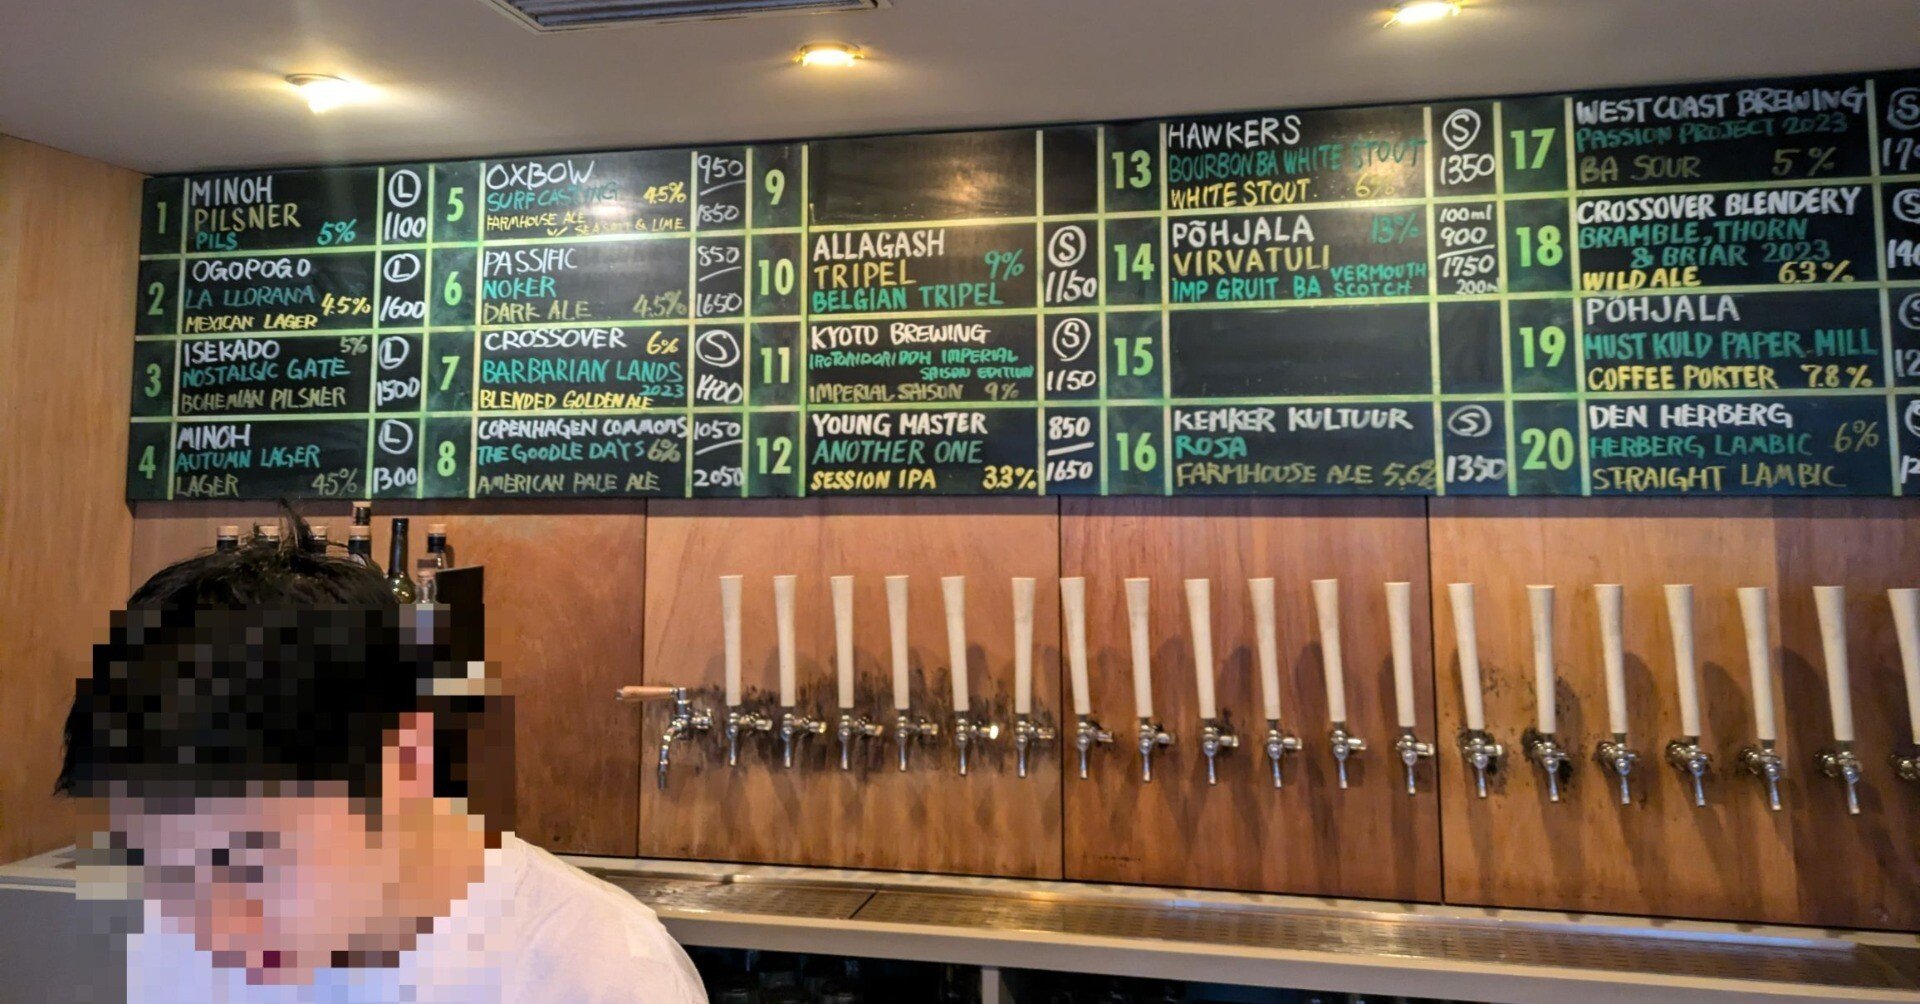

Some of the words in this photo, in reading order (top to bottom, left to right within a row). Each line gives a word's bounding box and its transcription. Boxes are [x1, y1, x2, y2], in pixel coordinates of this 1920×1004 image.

[1575, 99, 1653, 125] WEST
[1653, 93, 1730, 117] COAST
[1737, 86, 1867, 113] BREWING
[1168, 114, 1301, 150] HAWKERS
[1576, 127, 1673, 153] PASSION
[1678, 117, 1776, 145] PROJECT
[1783, 111, 1849, 135] 2023
[1169, 153, 1253, 184] BOURBON
[1256, 150, 1277, 177] BA
[1284, 143, 1342, 175] WHITE
[1351, 138, 1429, 169] STOUT
[1510, 128, 1556, 170] 17
[486, 160, 594, 190] OXBOW
[698, 155, 744, 184] 950
[1112, 149, 1152, 189] 13
[1440, 153, 1495, 186] 1350
[1579, 156, 1619, 184] BA
[1630, 154, 1701, 180] SOUR
[191, 175, 273, 206] MINOH
[765, 169, 785, 206] 9
[1171, 182, 1240, 211] WHITE
[1243, 178, 1312, 206] STOUT
[157, 202, 167, 234] 1
[194, 203, 301, 233] PILSNER
[447, 187, 464, 222] 5
[696, 205, 740, 226] 1850
[1439, 204, 1493, 223] 100ml
[1577, 193, 1716, 225] CROSSOVER
[1724, 187, 1861, 216] BLENDERY
[317, 219, 357, 246] 5%
[384, 211, 426, 241] 1100
[487, 213, 556, 231] FARMHOUSE
[563, 211, 586, 224] ALE
[652, 218, 686, 232] LIME
[1171, 214, 1316, 249] PÕHJALA
[1370, 213, 1420, 245] 13%
[1714, 217, 1809, 241] THORN
[195, 232, 238, 250] PILS
[813, 228, 946, 262] ALLAGASH
[1440, 226, 1489, 248] 900
[1515, 225, 1563, 268] 18
[484, 248, 578, 278] PASSIFIC
[697, 246, 740, 266] 850
[984, 248, 1025, 282] 9%
[1113, 243, 1155, 282] 14
[1173, 244, 1331, 277] VIRVATULI
[1441, 254, 1496, 278] 1750
[1630, 247, 1653, 269] &
[1661, 244, 1748, 266] BRIAR
[1762, 240, 1831, 262] 2023
[192, 258, 312, 282] OGOPOGO
[758, 258, 795, 296] 10
[813, 258, 917, 290] TRIPEL
[1330, 261, 1428, 284] VERMOUTH
[1581, 269, 1647, 292] WILD
[1653, 265, 1701, 289] ALE
[149, 282, 165, 315] 2
[184, 288, 213, 309] LA
[444, 271, 462, 306] 6
[482, 275, 557, 299] NOKER
[812, 285, 908, 314] BELGIAN
[918, 281, 1005, 307] TRIPEL
[1045, 271, 1098, 303] 1150
[1172, 277, 1209, 303] IMP
[1215, 276, 1280, 300] GRUIT
[1292, 274, 1322, 300] BA
[1333, 282, 1413, 297] SCOTCH
[380, 296, 426, 321] 1600
[482, 301, 541, 325] DARK
[548, 299, 592, 319] ALE
[696, 293, 742, 317] 1650
[185, 315, 255, 333] MEXICAN
[263, 313, 318, 329] LAGER
[811, 324, 879, 350] KYOTO
[889, 321, 991, 346] BREWING
[184, 339, 280, 367] ISEKADO
[339, 336, 368, 356] 5%
[484, 328, 628, 351] CROSSOVER
[645, 330, 679, 355] 6%
[1519, 325, 1567, 368] 19
[1585, 331, 1647, 361] MUST
[1652, 329, 1713, 359] KULD
[1721, 330, 1802, 359] PAPER
[1814, 328, 1878, 358] MILL
[760, 347, 790, 384] 11
[898, 350, 931, 366] DDH
[941, 347, 1019, 364] IMPERIAL
[1113, 336, 1155, 376] 15
[144, 363, 162, 397] 3
[182, 361, 279, 388] NOSTALGIC
[286, 357, 350, 380] GATE
[440, 355, 461, 391] 7
[482, 357, 612, 384] BARBARIAN
[616, 359, 684, 382] LANDS
[919, 366, 971, 379] SAISON
[977, 365, 1035, 380] EDITION
[1047, 370, 1096, 392] 1150
[1587, 365, 1676, 392] COFFEE
[1683, 364, 1779, 390] PORTER
[181, 389, 265, 413] BOHEMIAN
[270, 386, 347, 410] PILSNER
[377, 377, 420, 407] 1500
[480, 390, 556, 410] BLENDED
[627, 396, 655, 410] ALE
[639, 384, 685, 398] 2023
[696, 374, 743, 404] 1400
[809, 383, 895, 403] IMPERIAL
[897, 383, 964, 401] SAISON
[984, 381, 1020, 401] 9%
[478, 418, 597, 440] COPENHAGEN
[694, 420, 741, 440] 1050
[811, 413, 891, 438] YOUNG
[899, 412, 988, 436] MASTER
[1048, 416, 1091, 440] 850
[1174, 409, 1277, 433] KEMKER
[1288, 406, 1415, 432] KULTUUR
[1589, 404, 1648, 430] DEN
[1660, 403, 1793, 430] HERBERG
[176, 424, 251, 450] MINOH
[647, 438, 681, 463] 6%
[1175, 435, 1248, 460] ROSA
[1521, 427, 1574, 471] 20
[1590, 435, 1706, 459] HERBERG
[1715, 433, 1812, 456] LAMBIC
[1834, 420, 1880, 453] 6%
[139, 446, 156, 479] 4
[175, 450, 251, 473] AUTUMN
[260, 444, 321, 468] LAGER
[437, 440, 456, 477] 8
[477, 445, 511, 466] THE
[588, 439, 645, 463] DAYS
[756, 436, 792, 475] 12
[811, 439, 925, 465] ANOTHER
[933, 439, 984, 464] ONE
[1116, 432, 1157, 472] 16
[374, 467, 418, 493] 1300
[693, 469, 744, 487] 2050
[810, 469, 892, 492] SESSION
[898, 469, 937, 490] IPA
[1046, 461, 1094, 482] 1650
[1176, 461, 1318, 487] FARMHOUSE
[1326, 463, 1374, 484] ALE
[1446, 454, 1507, 484] 1350
[1593, 465, 1727, 492] STRAIGHT
[1741, 463, 1846, 489] LAMBIC
[175, 474, 239, 497] LAGER
[477, 472, 565, 496] AMERICAN
[573, 471, 618, 491] PALE
[625, 473, 661, 492] ALE
